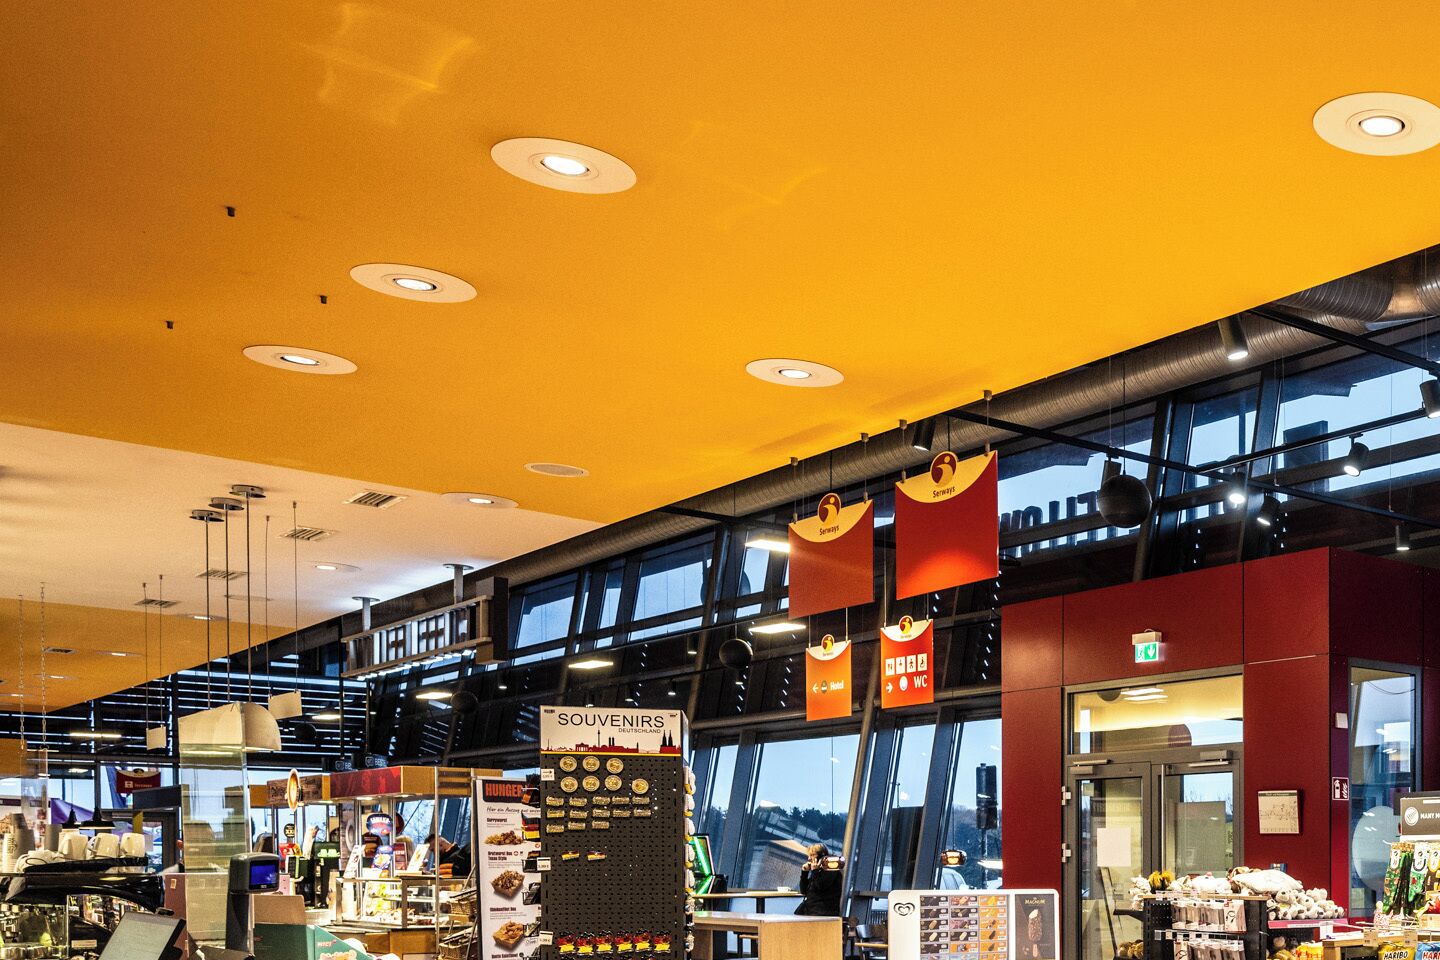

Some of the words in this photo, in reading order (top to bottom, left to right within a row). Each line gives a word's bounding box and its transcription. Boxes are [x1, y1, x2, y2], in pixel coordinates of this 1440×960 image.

[932, 486, 956, 498] Serways
[819, 525, 839, 536] Serways
[830, 680, 844, 691] Hotel
[913, 675, 928, 689] WC
[557, 713, 665, 729] SOUVENIRS
[1383, 951, 1409, 960] HARIBO
